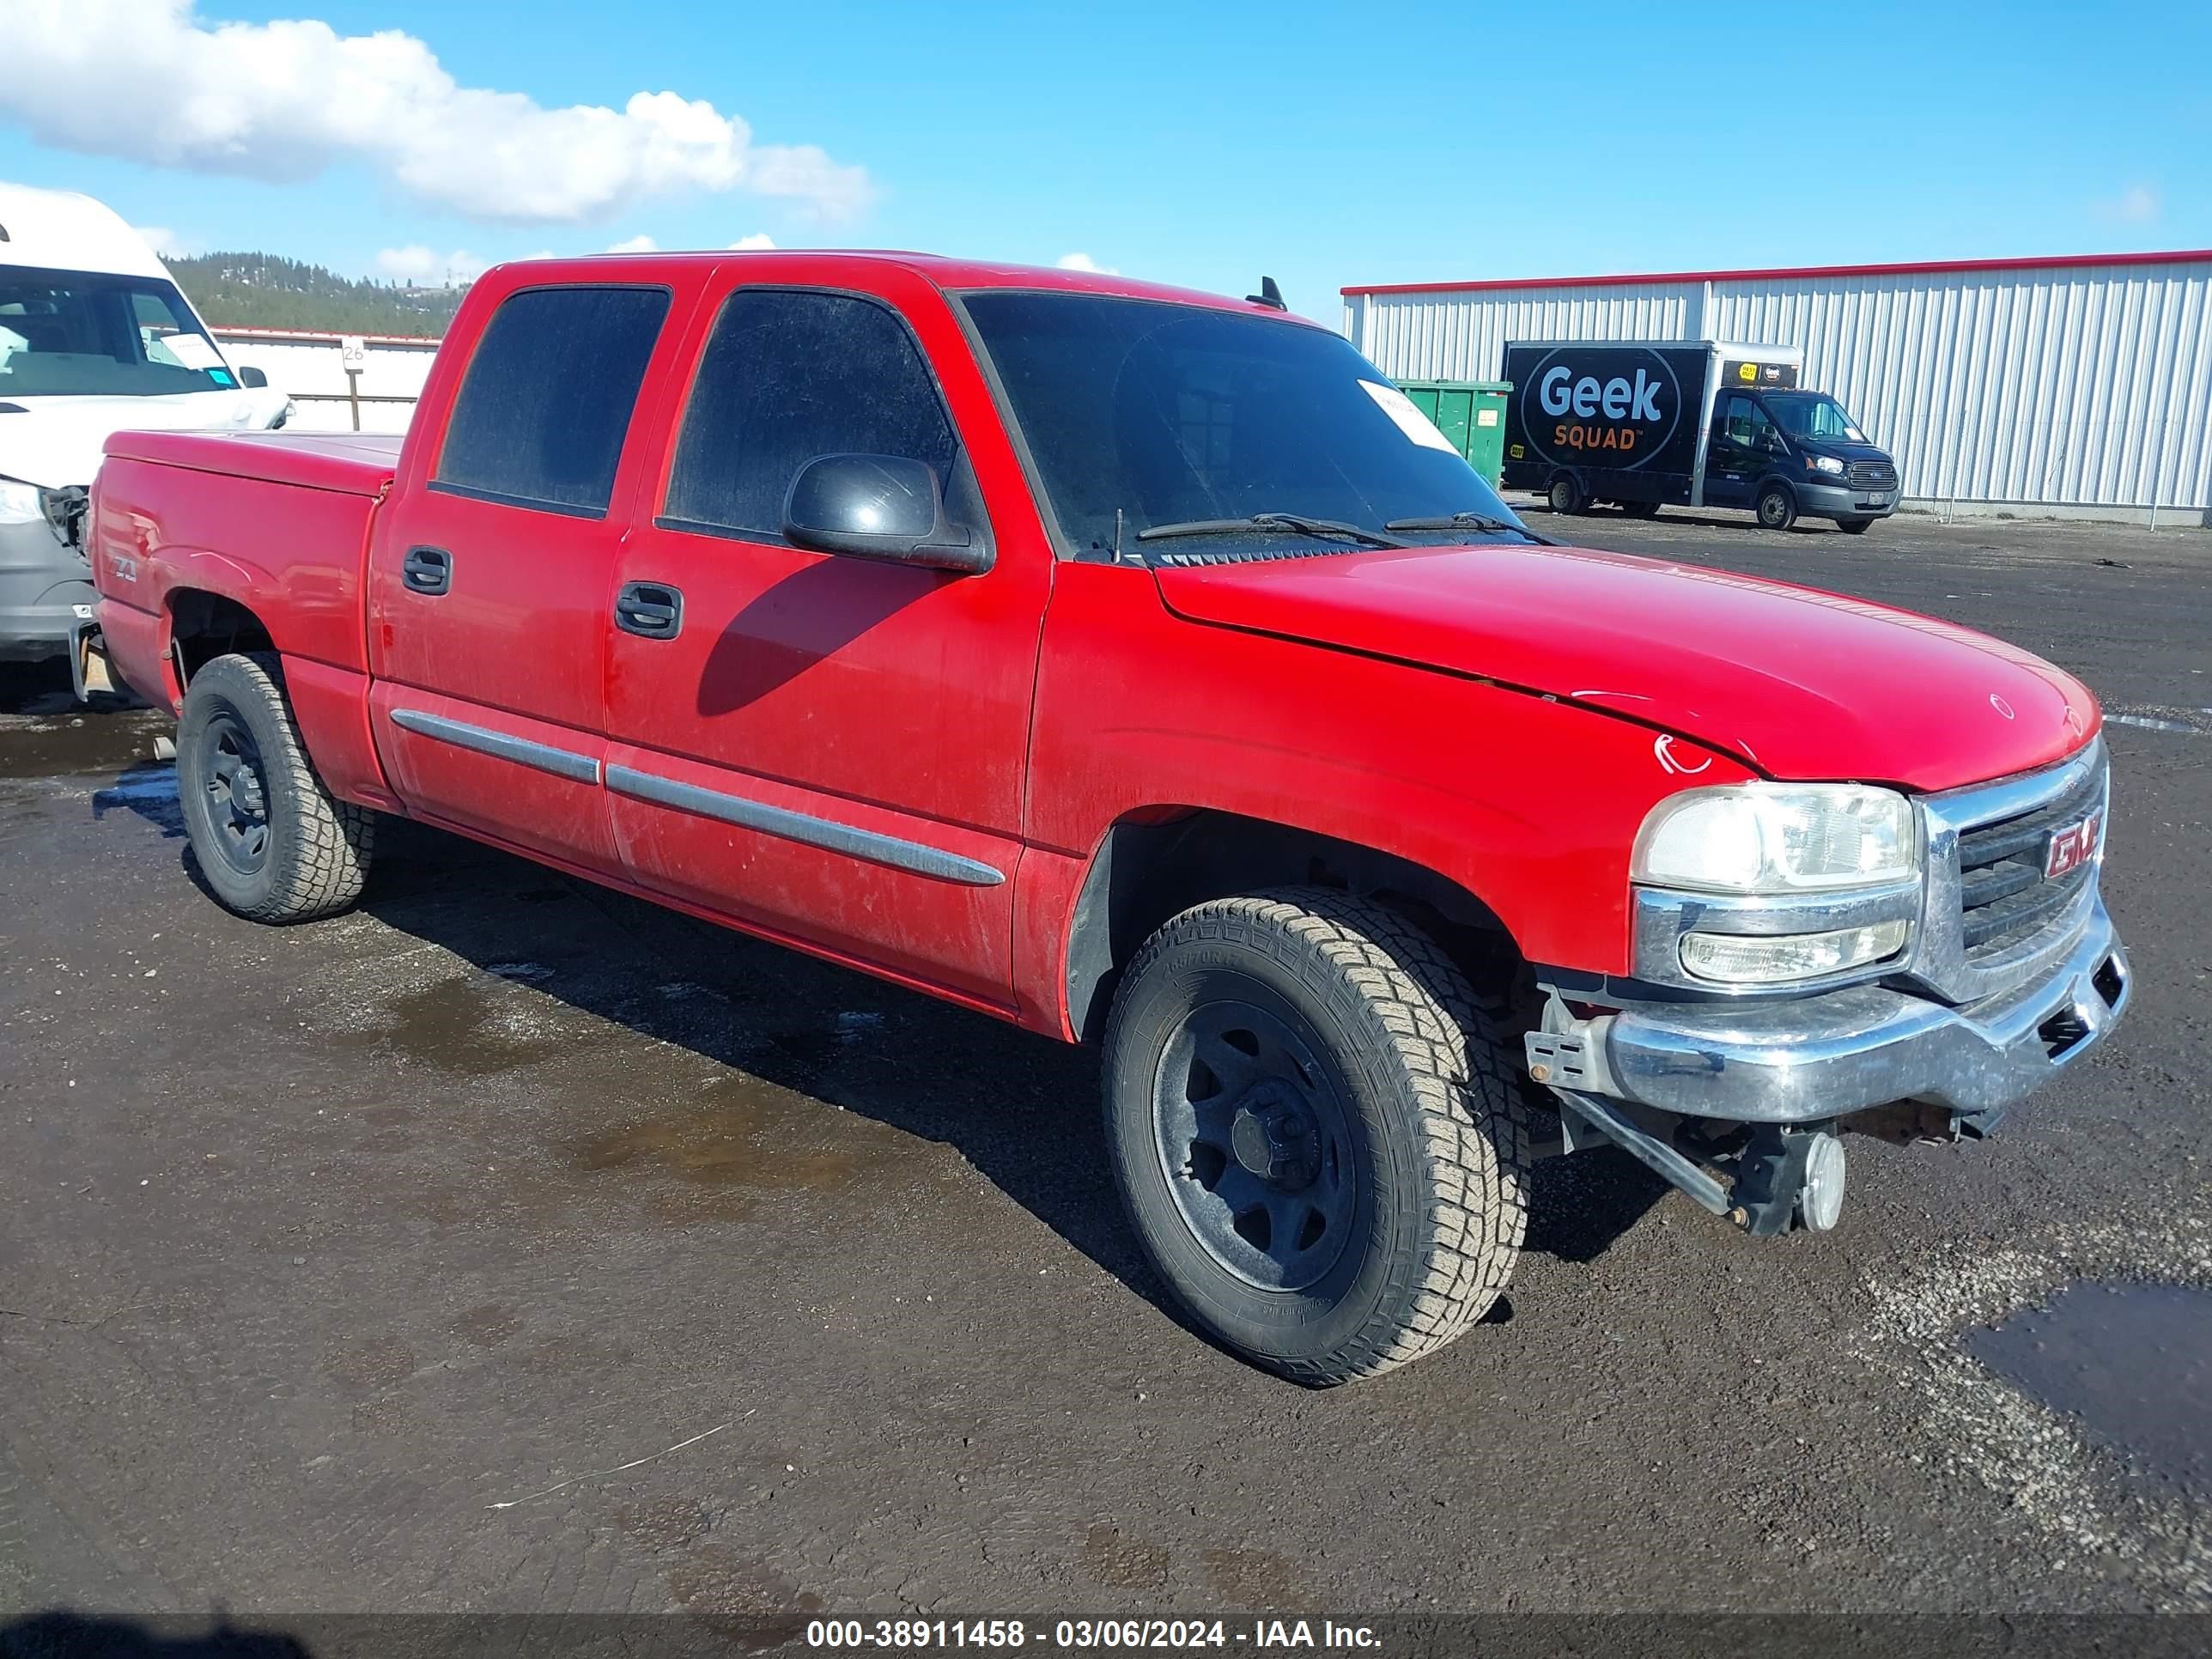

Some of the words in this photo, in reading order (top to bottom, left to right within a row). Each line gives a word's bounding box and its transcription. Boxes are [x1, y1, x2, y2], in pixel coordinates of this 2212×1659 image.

[343, 346, 363, 360] 26
[1540, 366, 1662, 421] Geek
[1553, 424, 1635, 450] SQUAD
